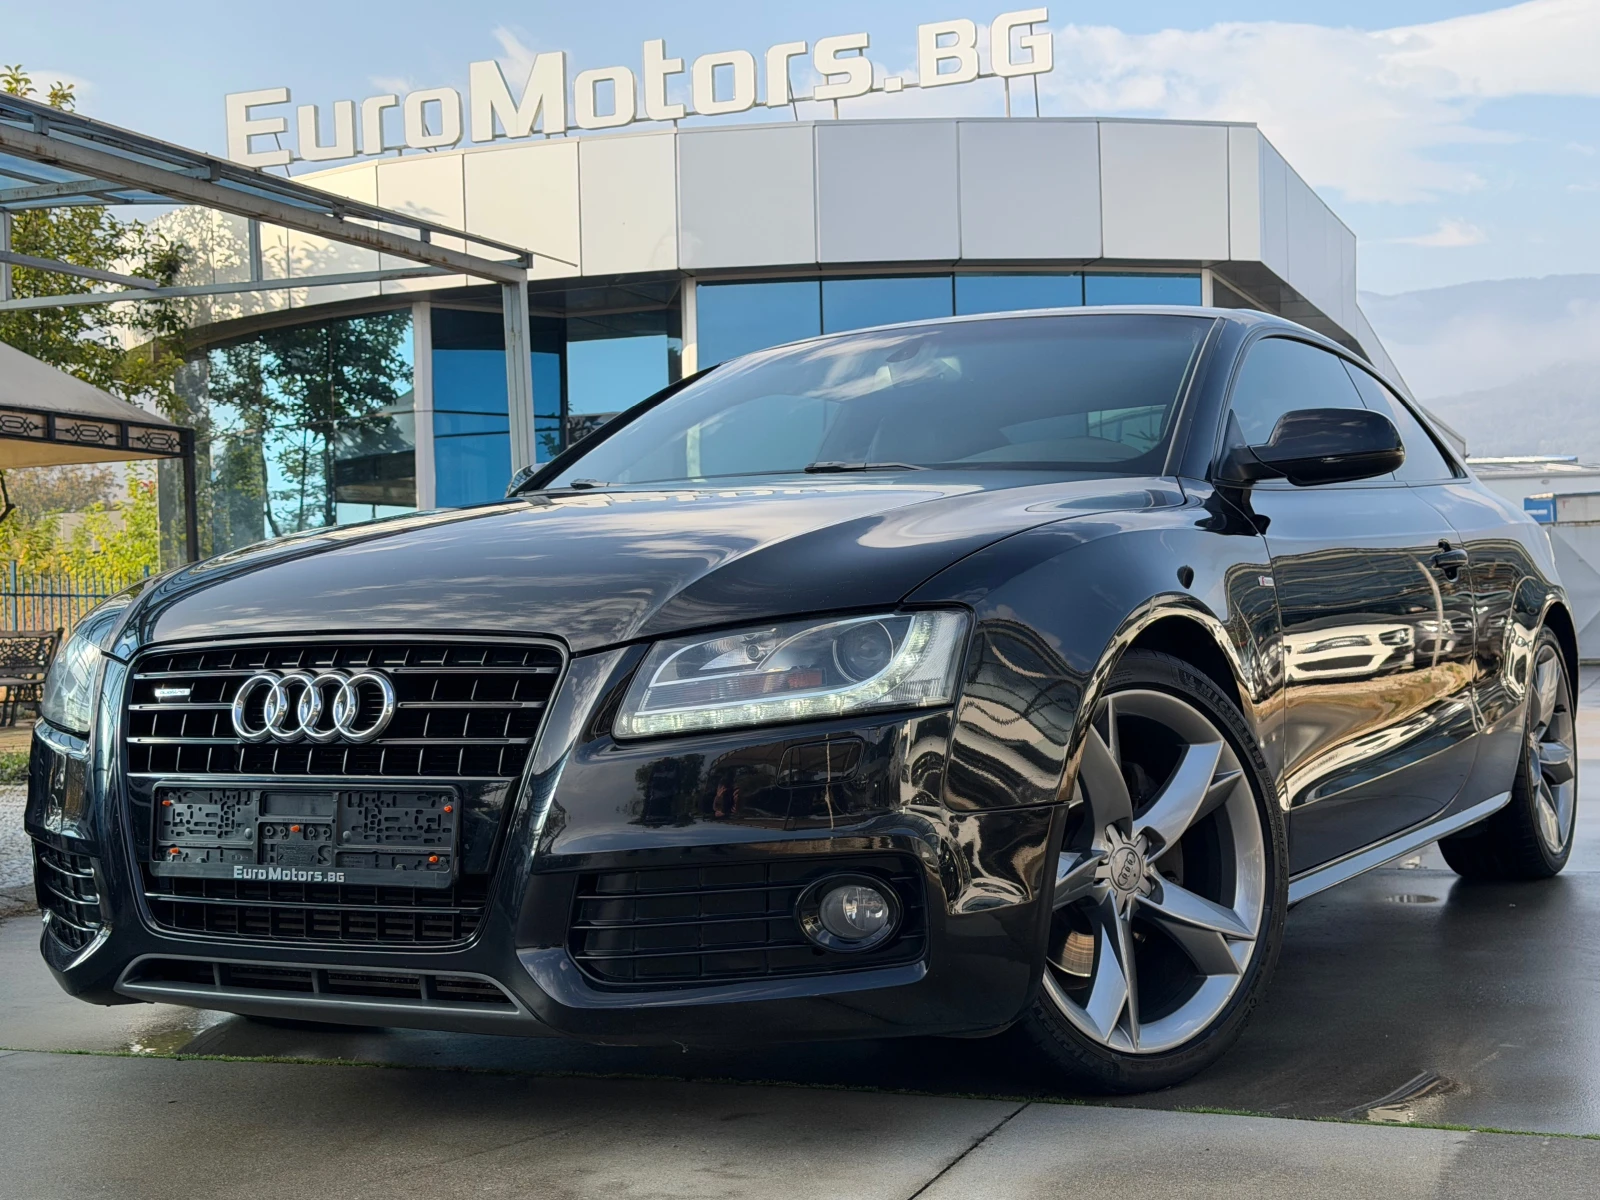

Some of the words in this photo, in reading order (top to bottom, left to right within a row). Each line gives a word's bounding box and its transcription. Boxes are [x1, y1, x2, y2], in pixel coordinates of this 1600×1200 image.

[224, 7, 1055, 169] EuroMotors.BG
[1199, 683, 1263, 765] MICHELIN
[1265, 775, 1277, 804] PILOT
[1275, 809, 1285, 845] SPORT
[233, 865, 345, 883] EuroMotors.BG
